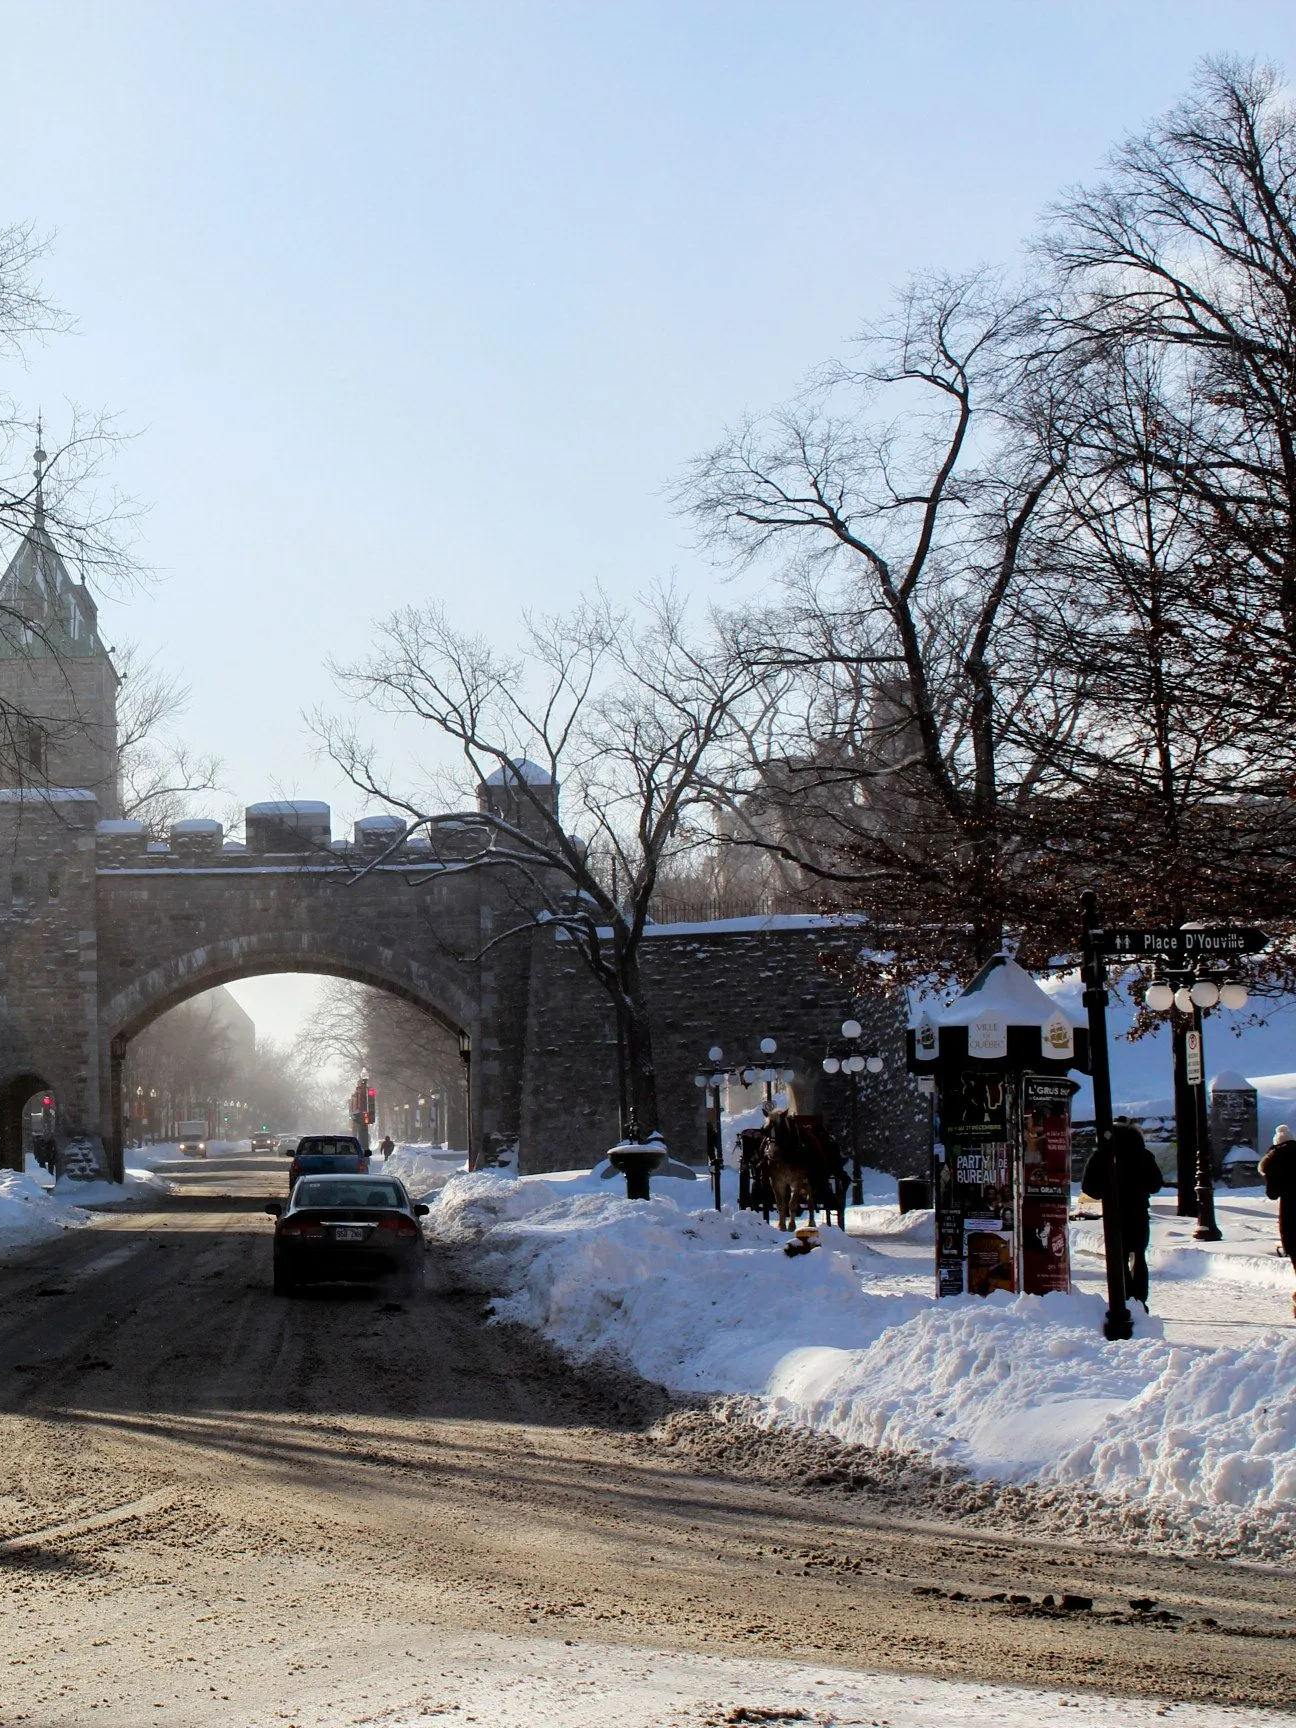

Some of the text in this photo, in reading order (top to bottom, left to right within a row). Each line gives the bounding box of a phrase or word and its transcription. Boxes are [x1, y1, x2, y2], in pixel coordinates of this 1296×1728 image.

[1144, 934, 1245, 949] Place D'Youville
[975, 1023, 998, 1031] VILLE
[957, 1155, 1008, 1169] PARTY DE
[957, 1170, 997, 1184] BUREAU
